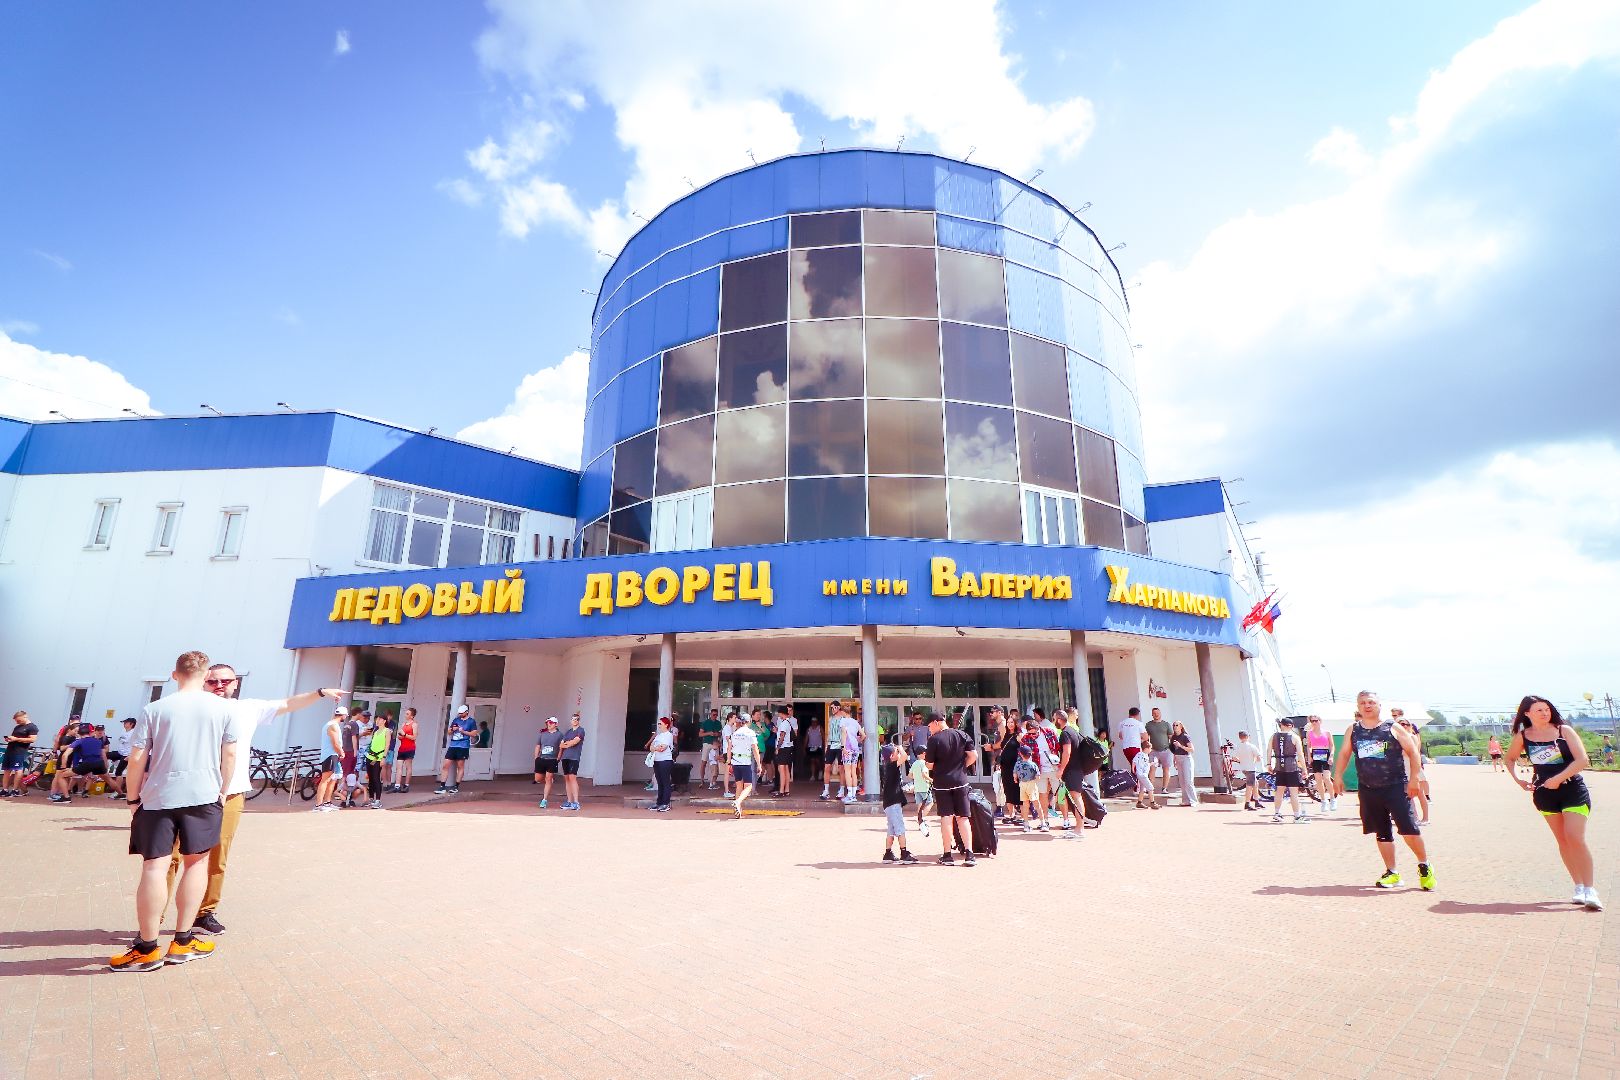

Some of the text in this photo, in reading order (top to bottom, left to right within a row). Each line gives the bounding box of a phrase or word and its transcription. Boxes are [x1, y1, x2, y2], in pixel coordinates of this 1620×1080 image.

[328, 568, 525, 625] ЛЕДОВЫЙ
[579, 560, 774, 616] ДВОРЕЦ
[822, 578, 909, 596] ИМЕНИ
